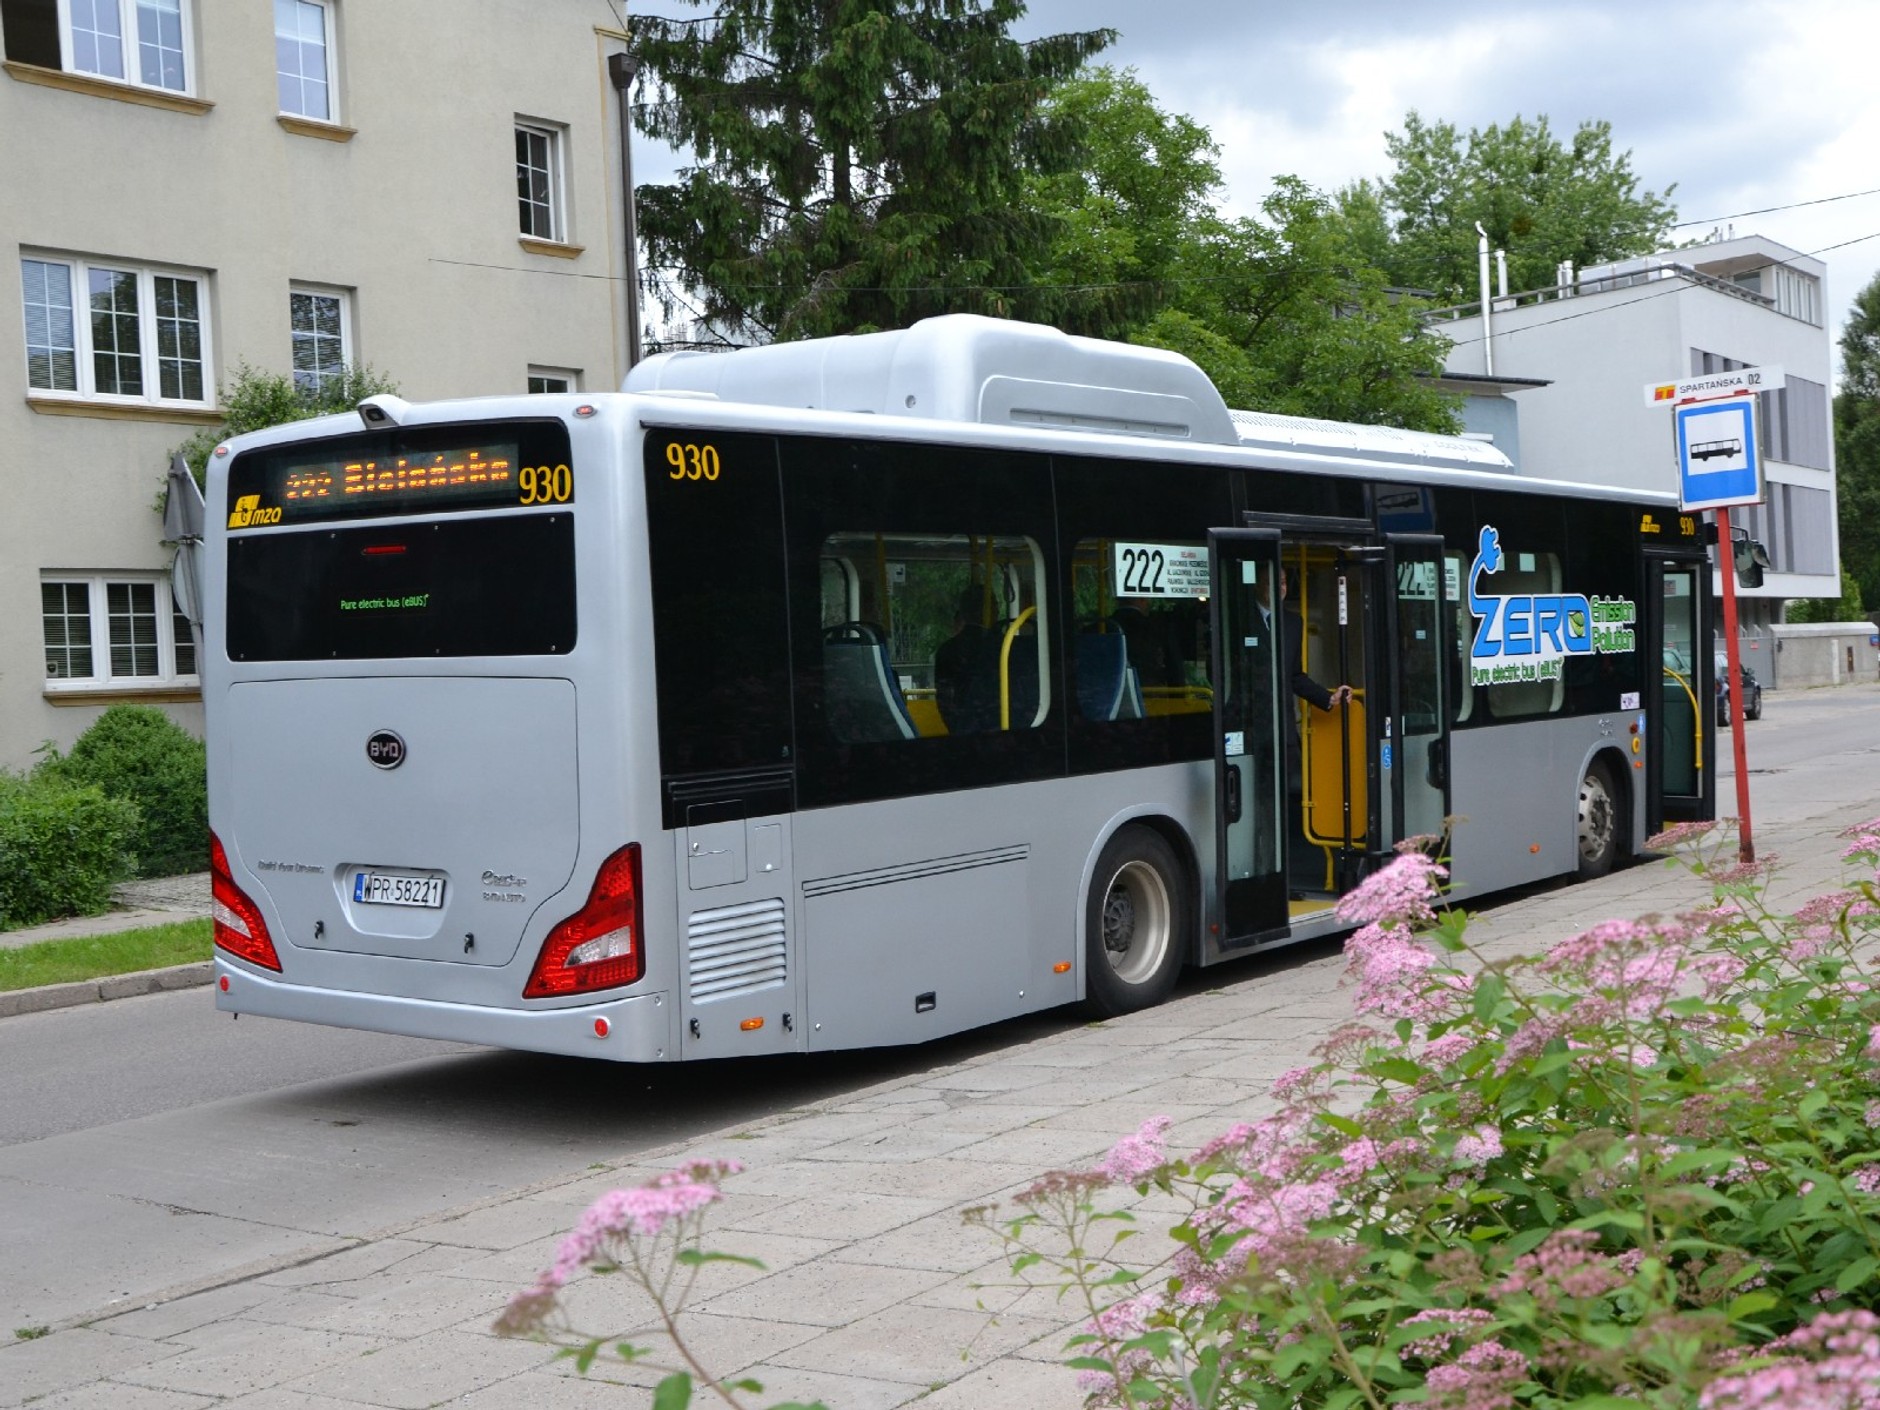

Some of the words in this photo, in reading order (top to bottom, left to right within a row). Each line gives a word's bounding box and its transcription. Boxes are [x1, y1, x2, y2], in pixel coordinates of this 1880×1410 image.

[1679, 377, 1743, 393] SPARTAŃSKA
[1747, 373, 1761, 386] 02
[666, 443, 721, 481] 930
[518, 464, 572, 504] 930
[1122, 548, 1165, 593] 222
[341, 600, 357, 610] Pure
[358, 598, 385, 609] electric
[386, 597, 401, 608] bus
[1472, 595, 1591, 658] ZERO
[1592, 596, 1635, 623] Emission
[1472, 666, 1490, 684] Pure
[370, 741, 399, 758] BYD
[363, 877, 391, 901] WPR
[395, 880, 438, 904] 58221
